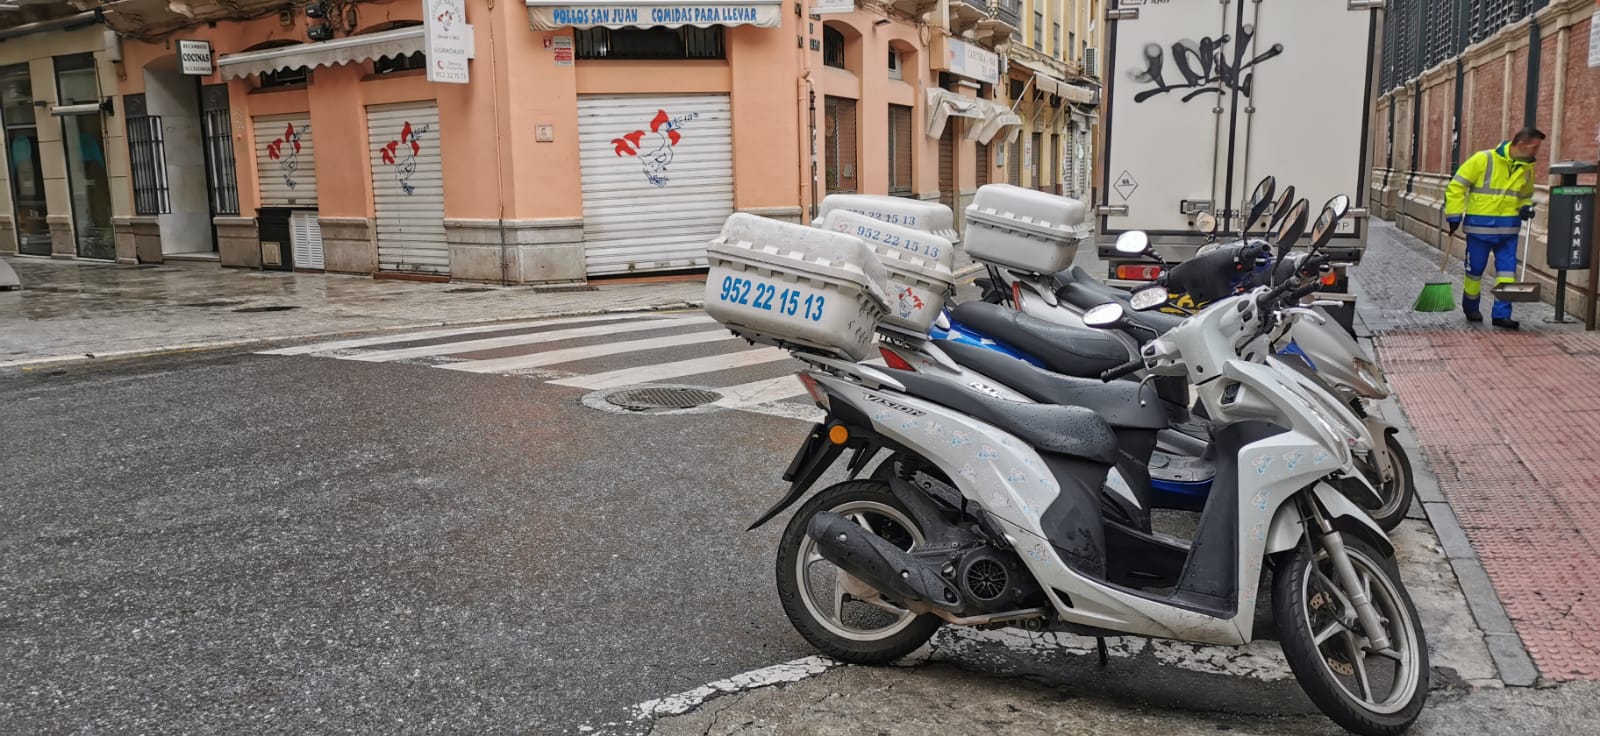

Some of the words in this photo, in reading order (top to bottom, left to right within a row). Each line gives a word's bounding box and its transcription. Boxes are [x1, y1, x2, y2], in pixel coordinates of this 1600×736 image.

[553, 8, 589, 24] POLLOS
[591, 8, 609, 24] SAN
[612, 8, 638, 23] JUAN
[651, 7, 692, 22] COMIDAS
[694, 7, 720, 22] PARA
[722, 7, 757, 21] LLEVAR
[183, 53, 209, 62] COCINAS
[886, 213, 899, 224] 15
[903, 215, 916, 226] 13
[1572, 199, 1582, 259] ÚSAME
[857, 225, 881, 241] 952
[883, 233, 900, 247] 22
[903, 239, 919, 252] 15
[922, 245, 939, 258] 13
[720, 275, 752, 305] 952
[752, 282, 776, 311] 22
[780, 288, 801, 316] 15
[804, 294, 825, 322] 13
[863, 392, 927, 416] VISION
